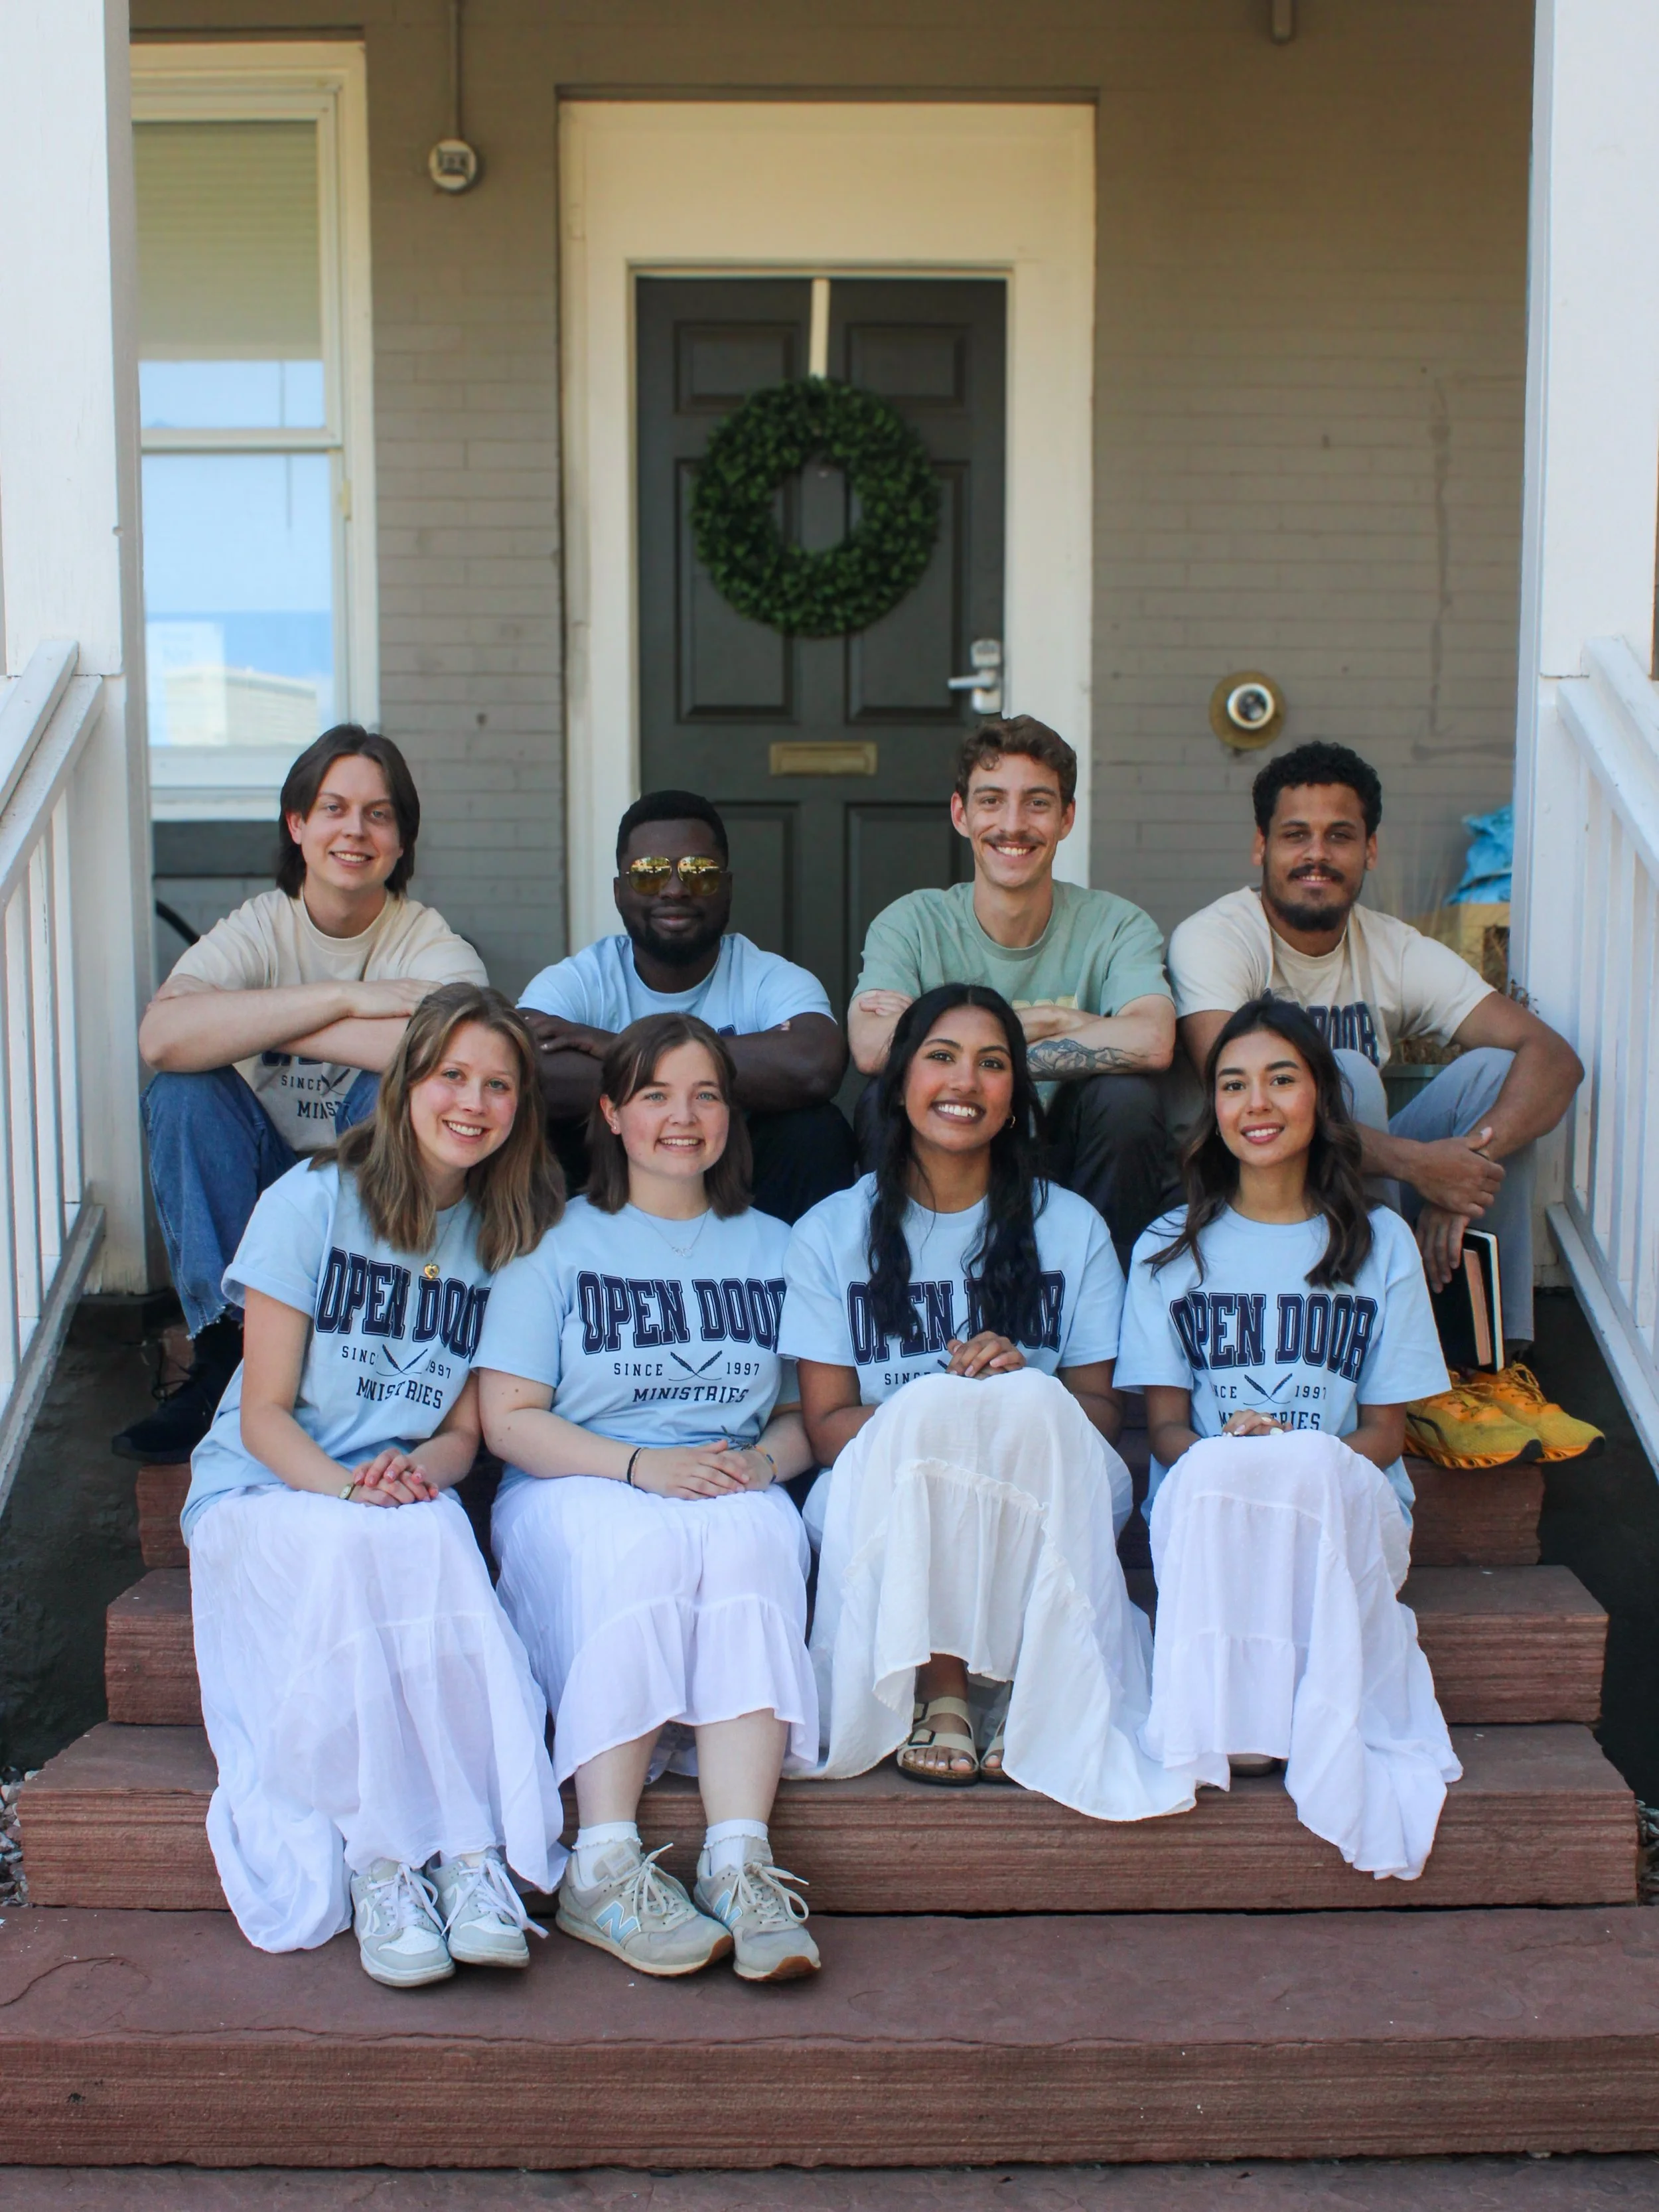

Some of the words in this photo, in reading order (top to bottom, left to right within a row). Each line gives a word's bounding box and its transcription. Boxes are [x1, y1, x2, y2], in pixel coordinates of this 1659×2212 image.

[281, 1074, 322, 1091] SINCE
[315, 1247, 412, 1340] OPEN
[569, 1270, 690, 1355] OPEN
[847, 1281, 957, 1366] OEN
[1169, 1291, 1267, 1370] OPEN
[1275, 1293, 1378, 1383] DOOR
[342, 1345, 379, 1365] SINC
[614, 1362, 663, 1376] SINCE
[727, 1361, 760, 1376] 1997
[632, 1385, 749, 1404] MINISTRIES
